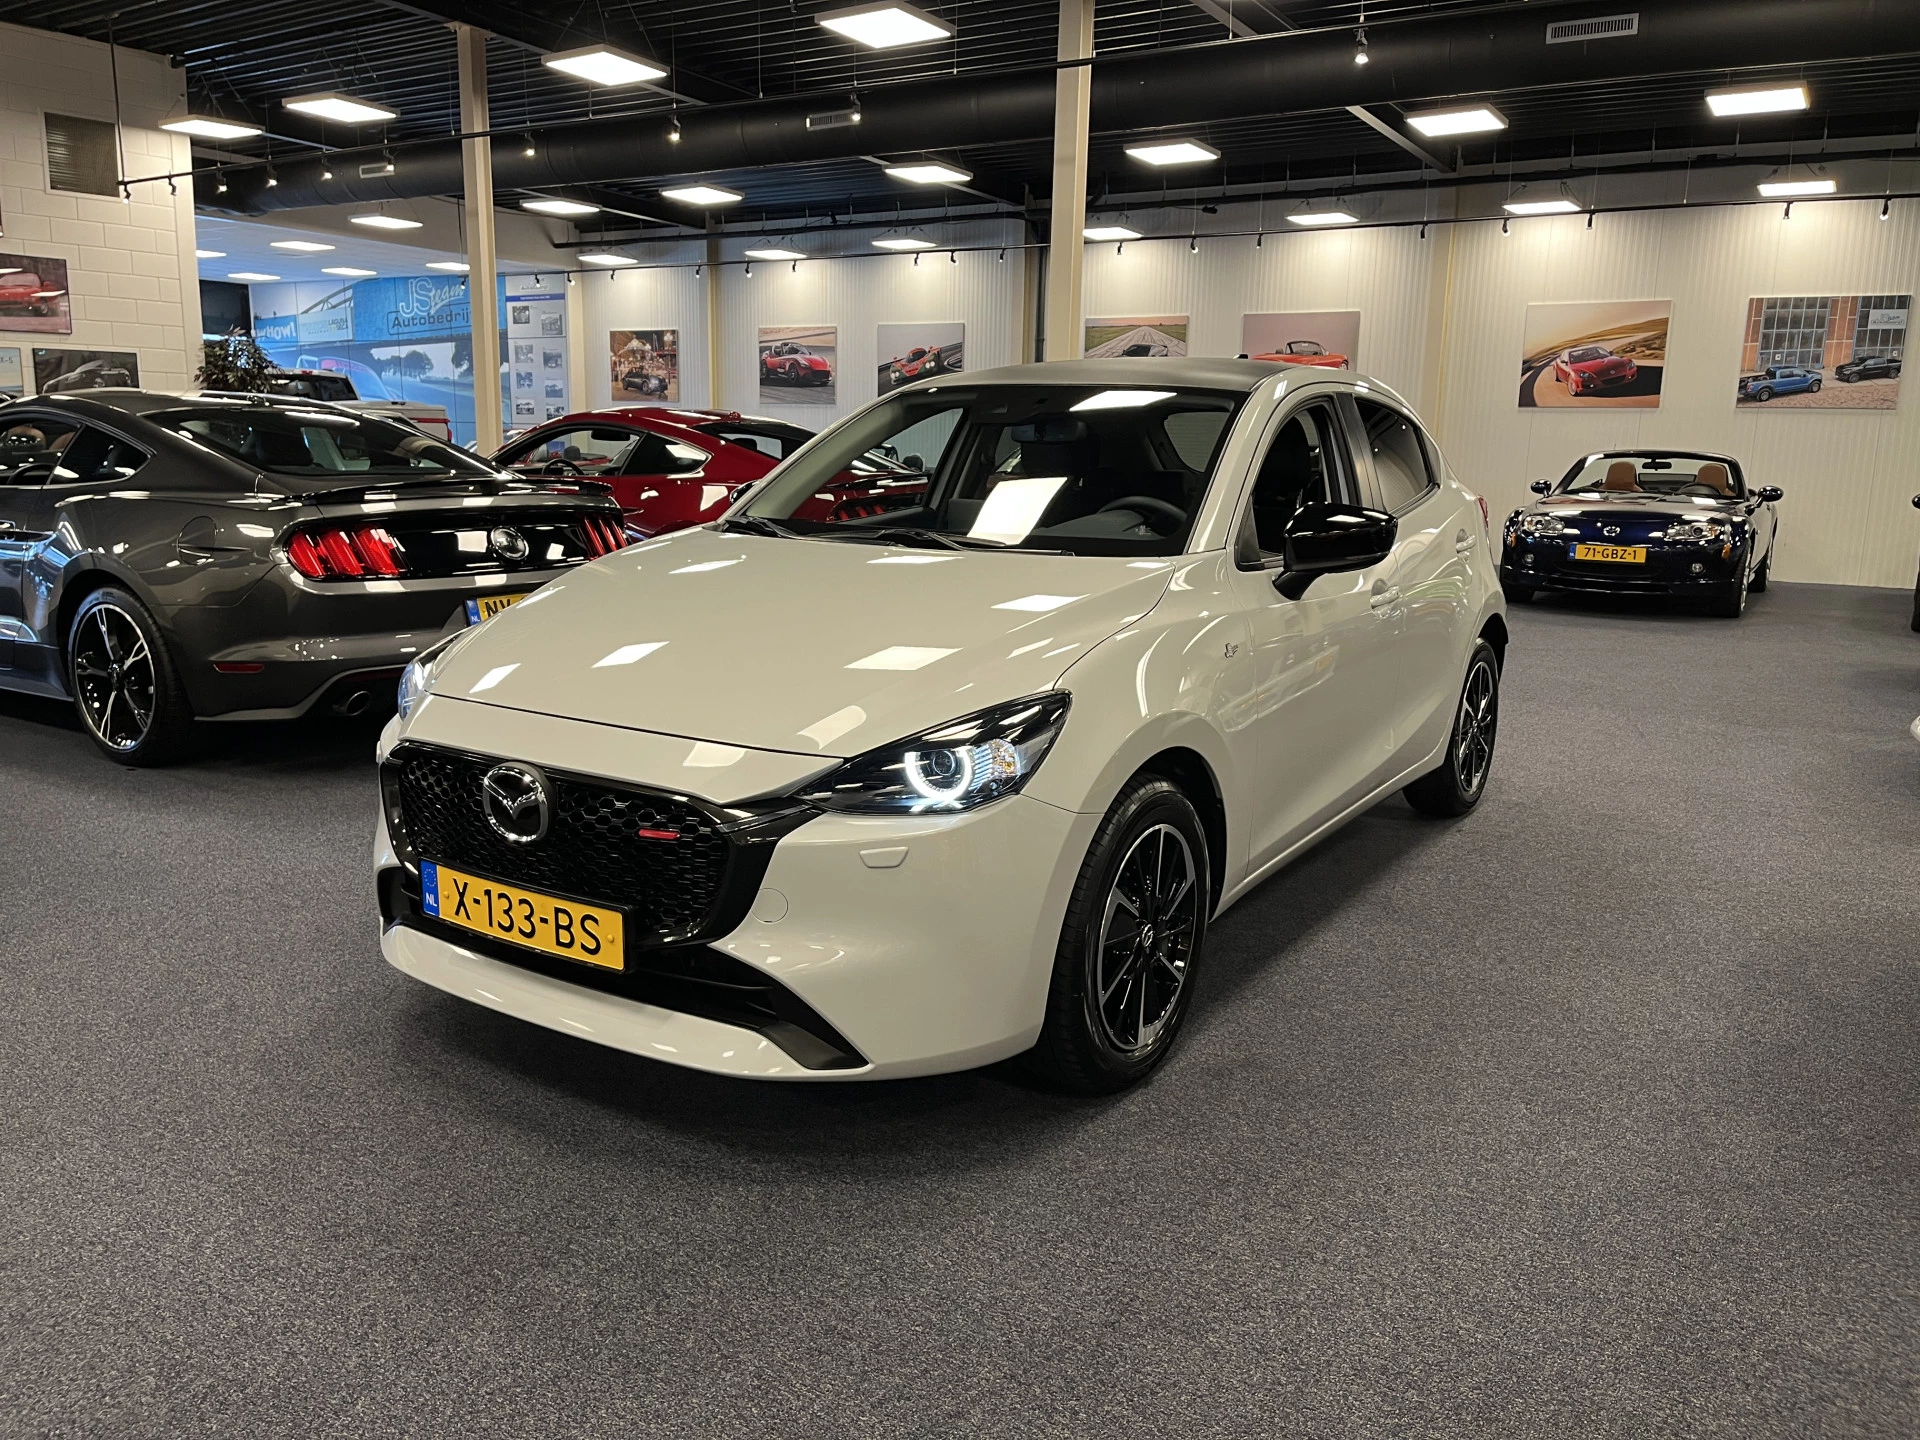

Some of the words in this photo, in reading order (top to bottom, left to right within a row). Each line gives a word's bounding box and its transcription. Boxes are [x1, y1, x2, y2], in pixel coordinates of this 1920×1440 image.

[391, 307, 472, 329] Autobedrij
[1584, 547, 1637, 560] 71-GBZ-1
[425, 892, 438, 907] NL
[452, 877, 602, 956] X-133-BS
